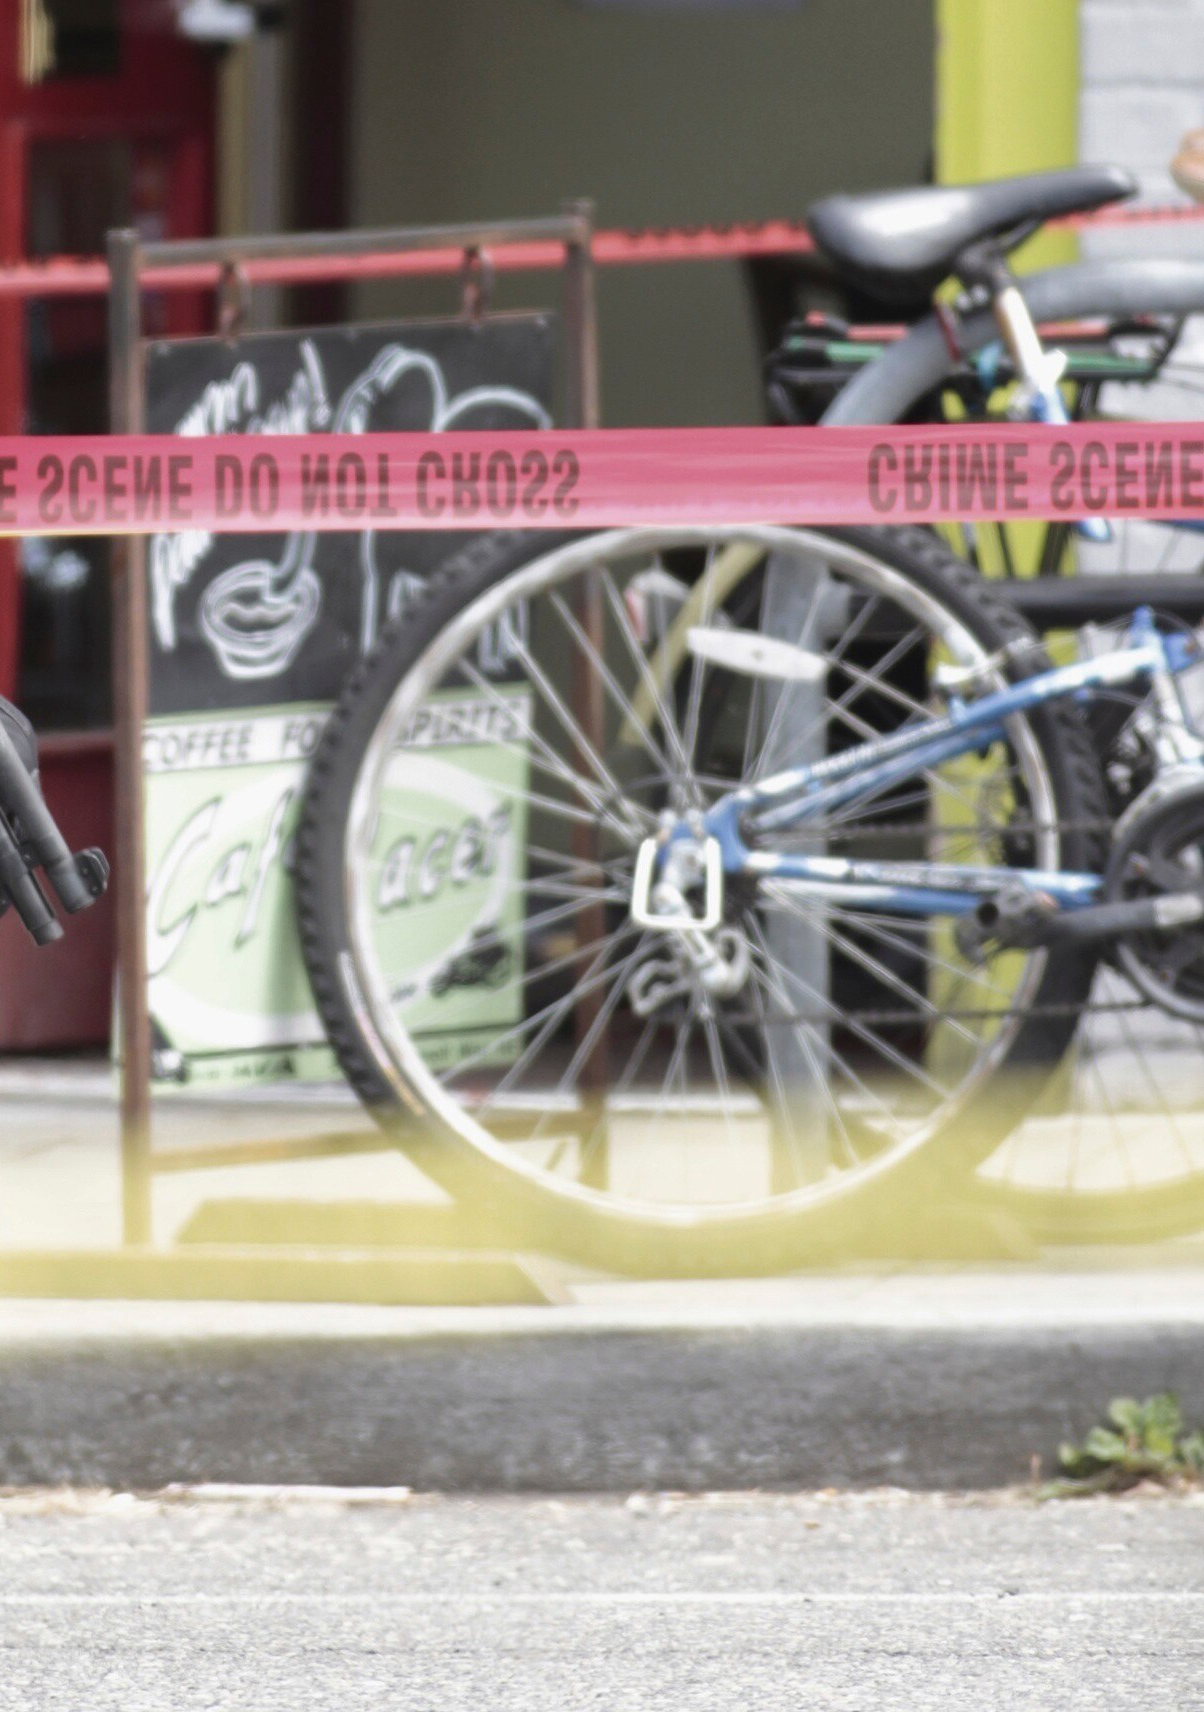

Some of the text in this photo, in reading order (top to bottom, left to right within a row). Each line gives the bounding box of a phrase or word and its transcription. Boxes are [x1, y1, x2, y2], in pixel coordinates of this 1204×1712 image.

[143, 723, 253, 766] COFFEE
[282, 717, 319, 756] FO
[146, 788, 513, 978] Caf acer
